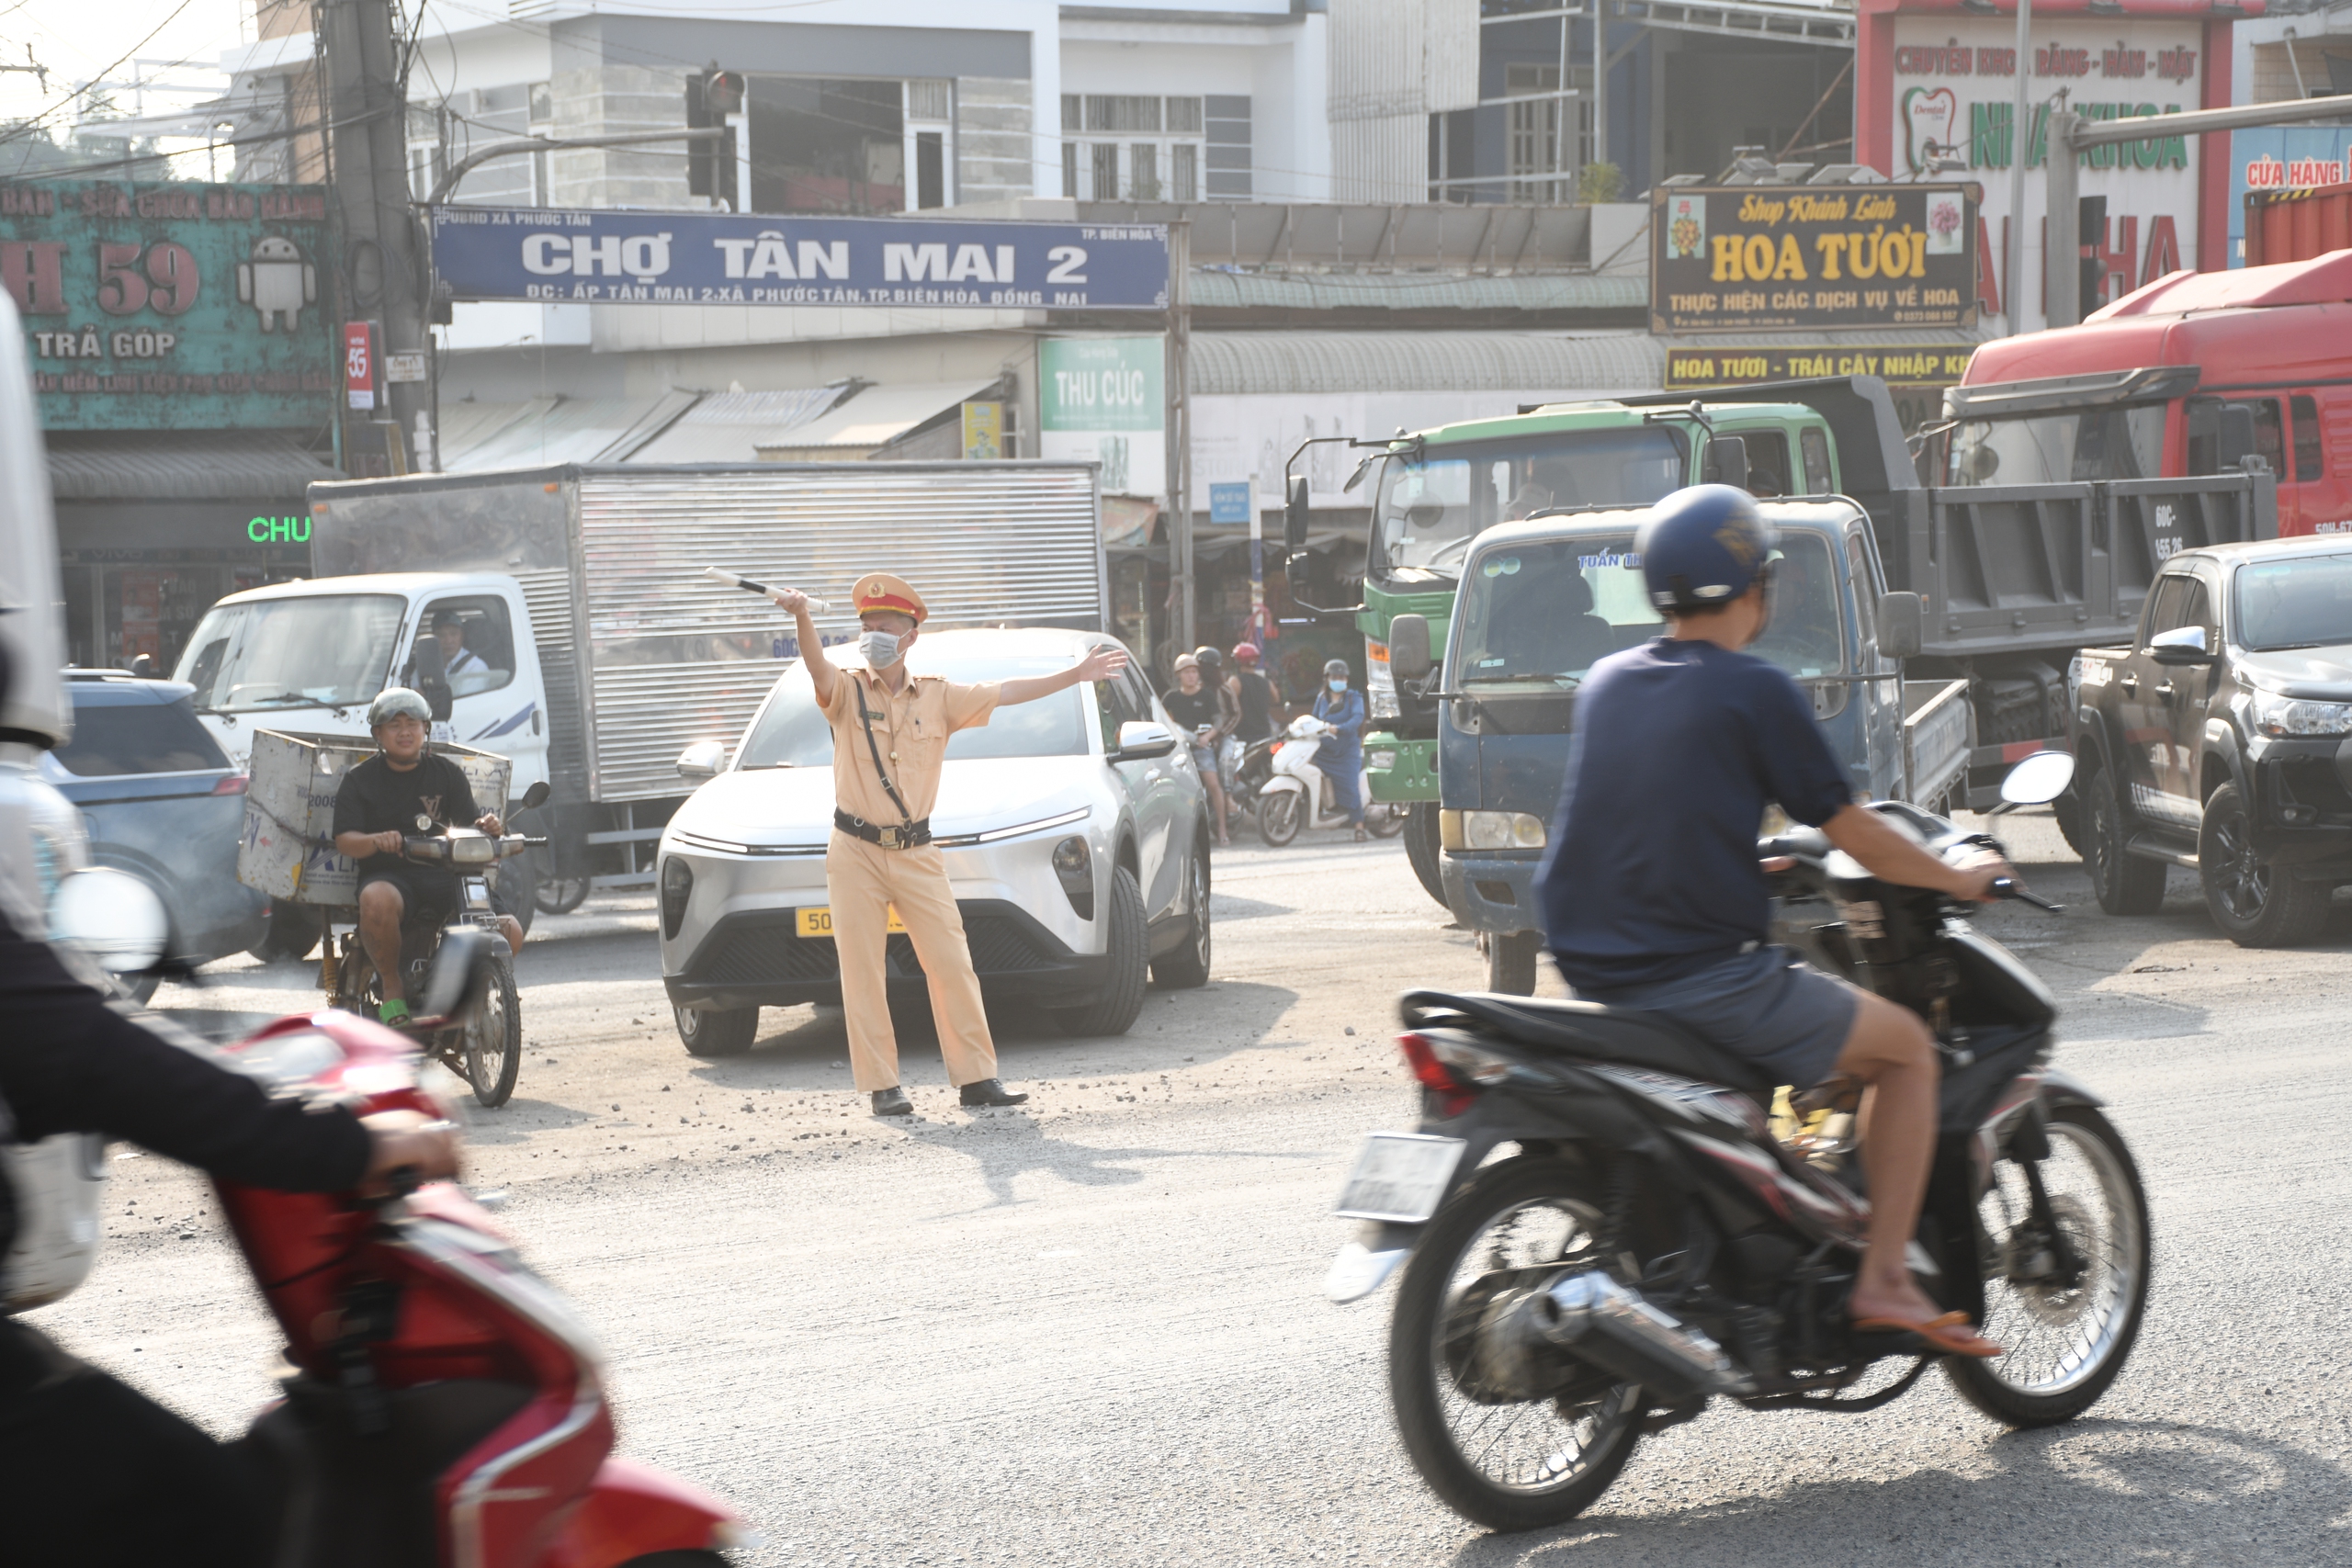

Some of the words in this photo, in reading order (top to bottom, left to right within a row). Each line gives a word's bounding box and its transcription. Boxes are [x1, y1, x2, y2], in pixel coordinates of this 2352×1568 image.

[1895, 37, 1973, 75] CHUYÊN
[1977, 45, 2030, 75] KHO
[2035, 42, 2090, 77] RĂNG
[2102, 39, 2146, 77] HÀM
[2158, 44, 2197, 85] MẶT
[2247, 154, 2285, 186] CỬA
[2289, 156, 2342, 186] HÀNG
[1738, 194, 1785, 227] Shop
[1100, 226, 1127, 241] BIÊN
[1129, 226, 1153, 241] HÒA
[522, 231, 673, 284] CHỢ
[714, 230, 850, 280] TÂN
[884, 243, 1015, 283] MAI
[1046, 245, 1088, 283] 2
[1711, 233, 1808, 281] HOA
[1815, 222, 1928, 280] TƯƠI
[97, 241, 199, 315] 59
[573, 282, 599, 300] ẤP
[608, 282, 649, 301] TÂN
[655, 286, 694, 301] MAI
[896, 286, 938, 305] BIÊN
[943, 286, 980, 305] HÒA
[1055, 293, 1088, 306] NAI
[1669, 293, 1717, 314] THỰC
[1723, 289, 1766, 313] HIỆN
[1771, 288, 1809, 310] CÁC
[1815, 290, 1858, 312] DỊCH
[1864, 290, 1888, 312] VỤ
[1923, 288, 1960, 306] HOA
[36, 325, 102, 358] TRẢ
[112, 329, 175, 357] GÓP
[348, 347, 367, 378] 5G
[1673, 359, 1715, 378] HOA
[1721, 356, 1768, 378] TƯƠI
[1787, 355, 1833, 378] TRÁI
[1838, 353, 1876, 377] CÂY
[1883, 353, 1939, 378] NHẬP
[1055, 369, 1096, 407] THU
[1102, 359, 1145, 407] CÚC
[247, 516, 311, 543] CHU
[1577, 547, 1619, 570] TUẤN
